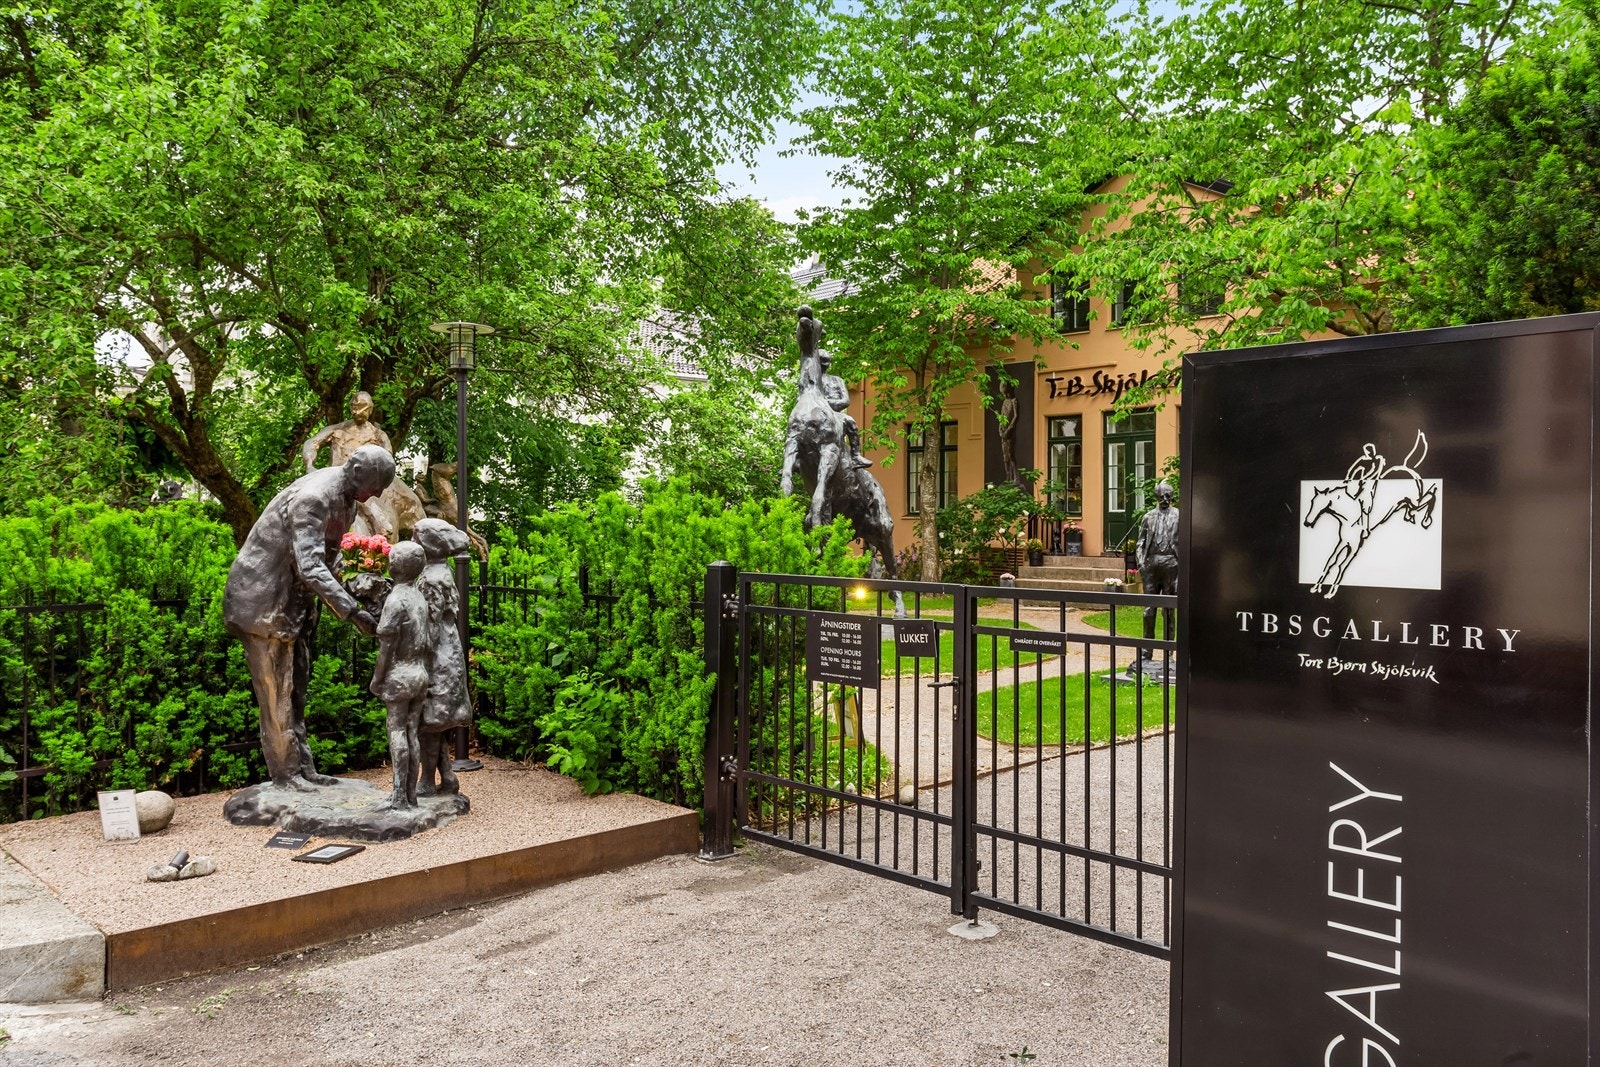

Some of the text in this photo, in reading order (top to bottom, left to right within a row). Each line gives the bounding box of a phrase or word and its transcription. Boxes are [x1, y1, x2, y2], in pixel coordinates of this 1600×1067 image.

[820, 618, 862, 631] ÅPNINGSTIDER
[1236, 611, 1520, 652] TBSGALLERY
[900, 633, 929, 644] LUKKET
[820, 646, 862, 657] OPENING HOURS
[1297, 653, 1323, 669] Tore
[1327, 656, 1366, 676] Bjørn
